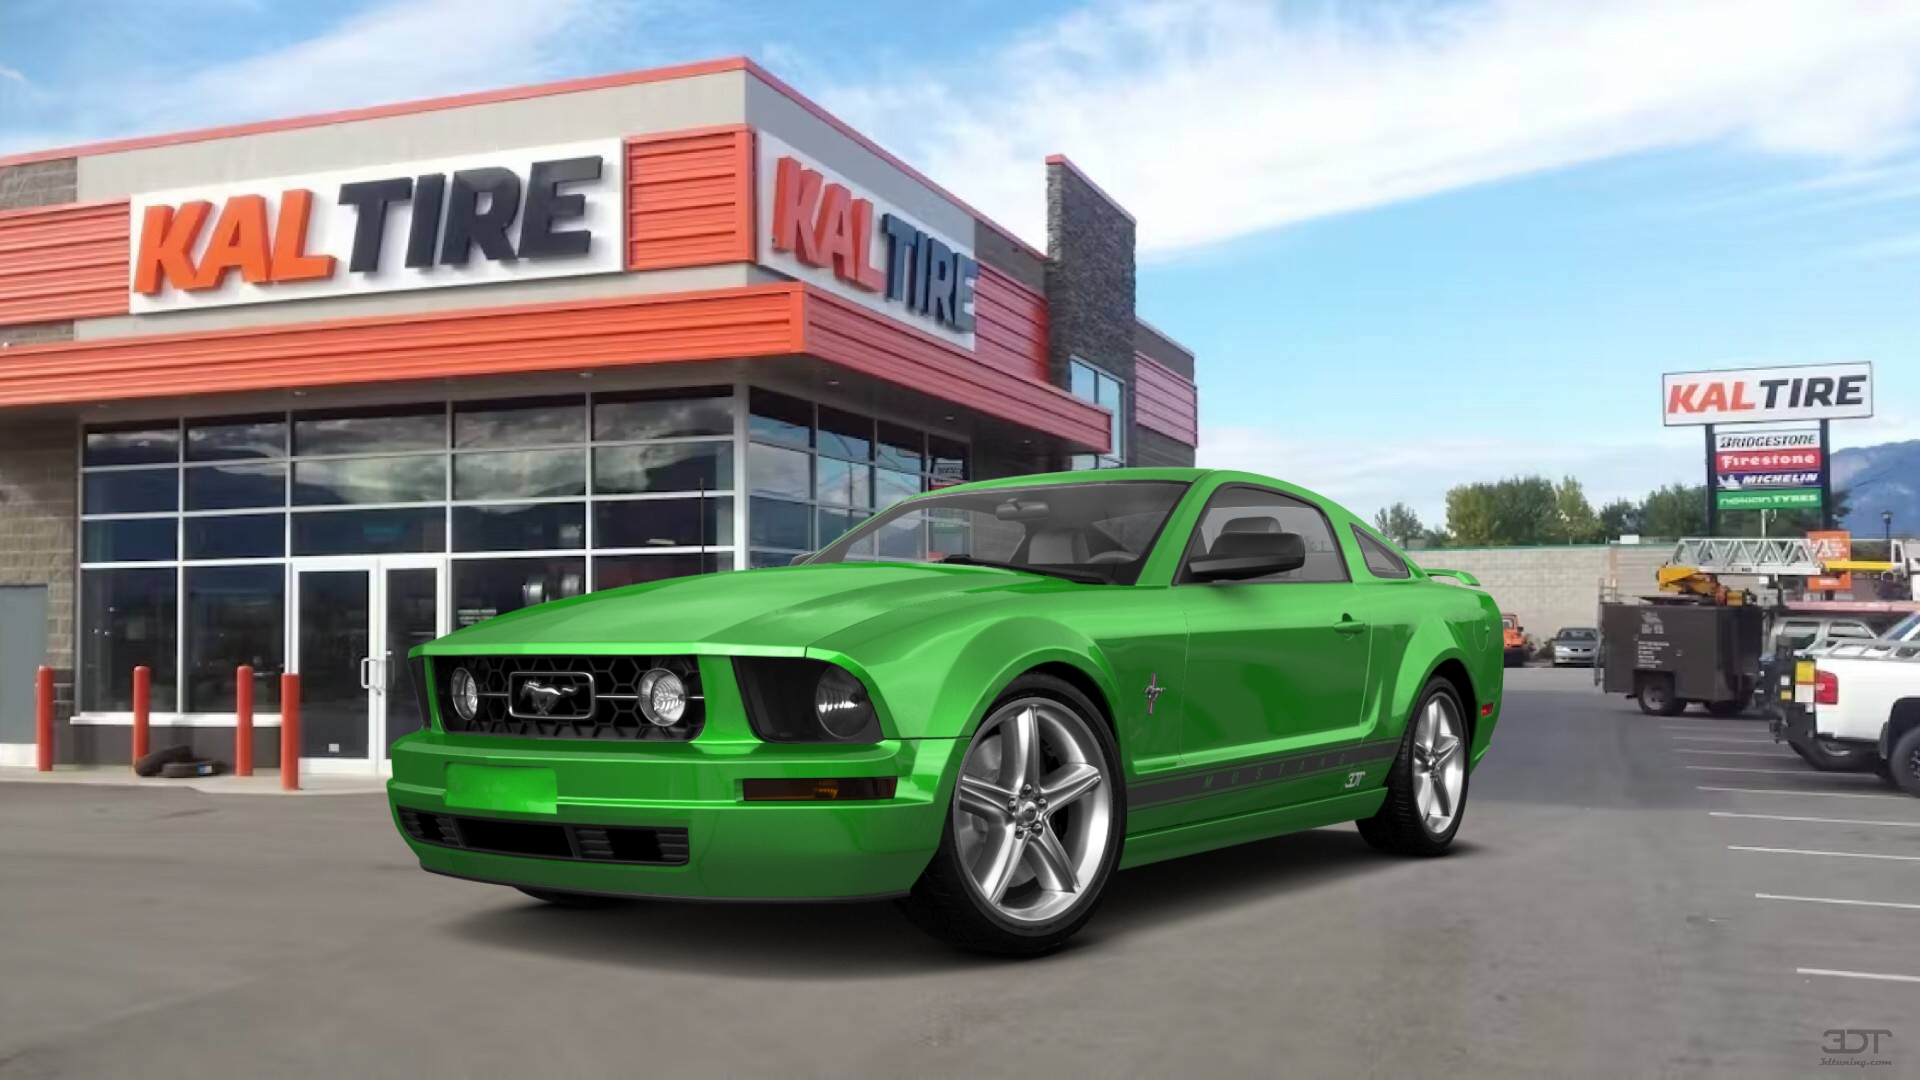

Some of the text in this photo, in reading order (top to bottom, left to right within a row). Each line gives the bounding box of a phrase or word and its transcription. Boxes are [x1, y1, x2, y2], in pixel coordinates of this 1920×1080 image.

[133, 155, 604, 295] KAL TIRE
[772, 156, 978, 334] KAL TIRE
[1667, 374, 1867, 414] KAL TIRE
[1720, 434, 1816, 449] BRIDGESTONE
[1720, 454, 1816, 469] Firestone
[1742, 472, 1818, 485] MICHELIN
[1203, 753, 1346, 789] MUSTANG
